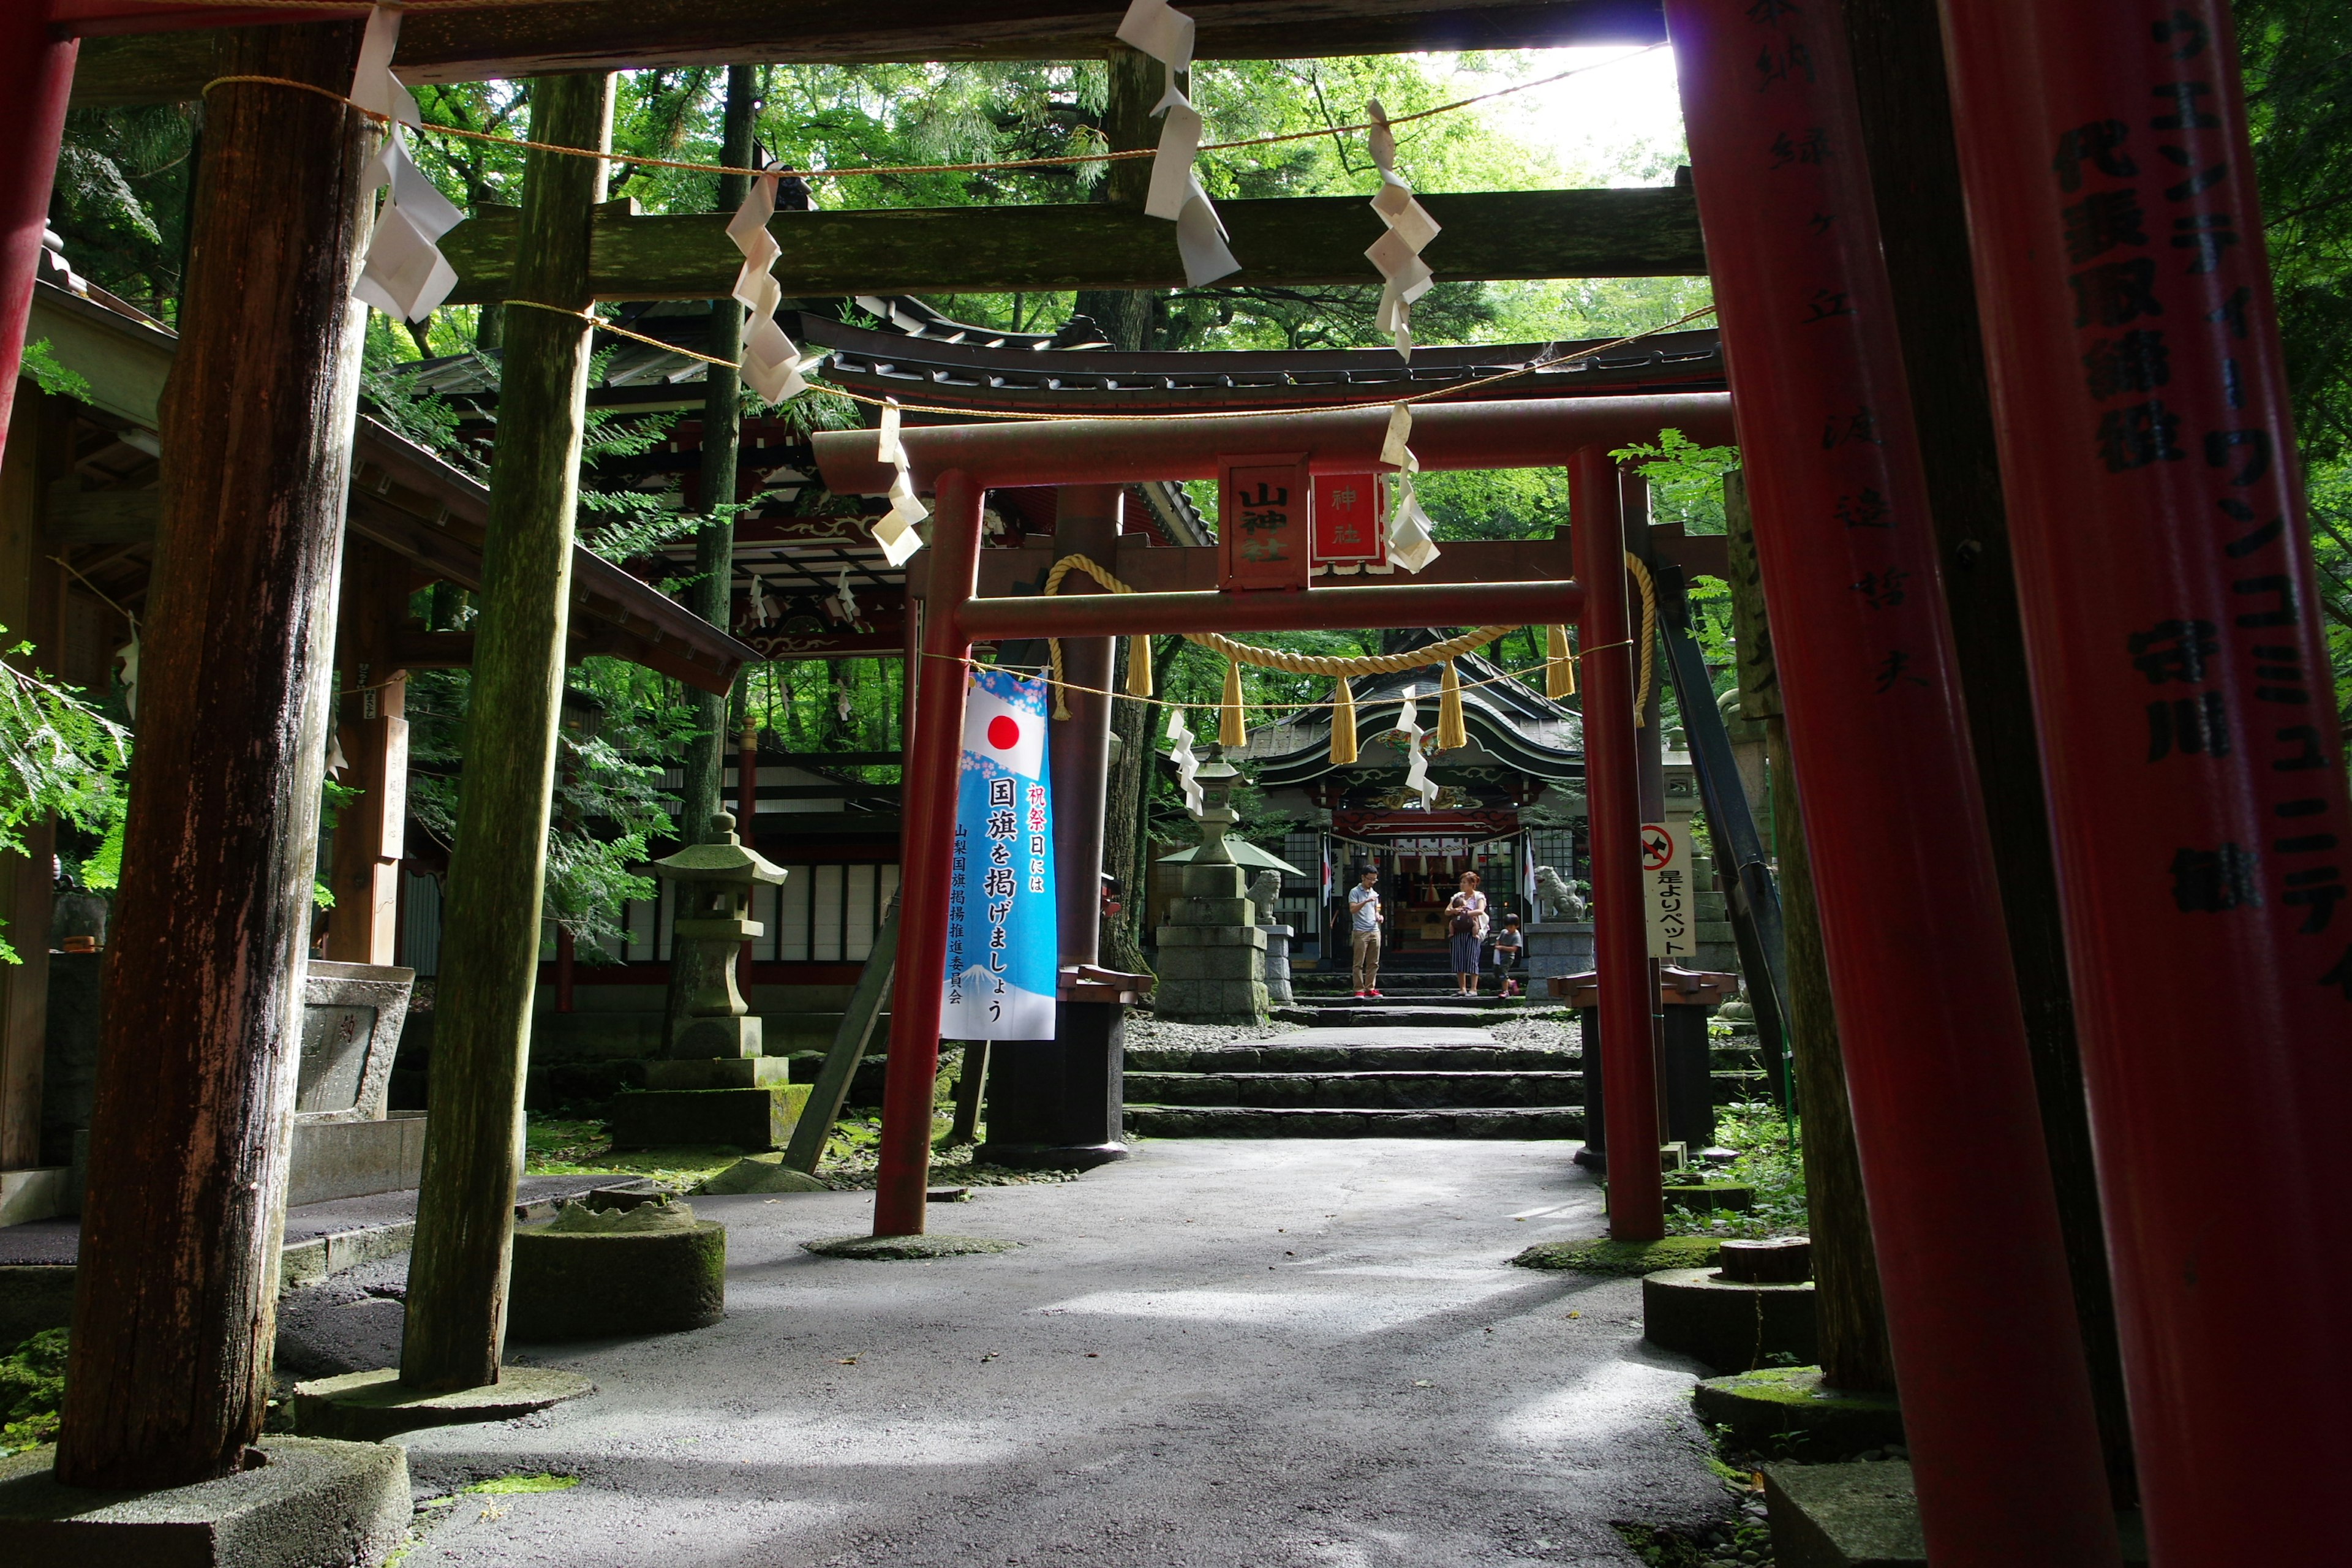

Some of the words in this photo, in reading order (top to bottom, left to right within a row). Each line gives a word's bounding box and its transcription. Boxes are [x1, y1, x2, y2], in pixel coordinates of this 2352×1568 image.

[1238, 481, 1289, 563] 山神社
[1331, 484, 1361, 545] 神社
[1026, 783, 1047, 893] 祝祭日には
[948, 824, 968, 1006] 山梨国旗掲揚推進委員会
[984, 777, 1017, 1023] 国旗を掲げましょう
[1657, 870, 1685, 955] 是よりペット
